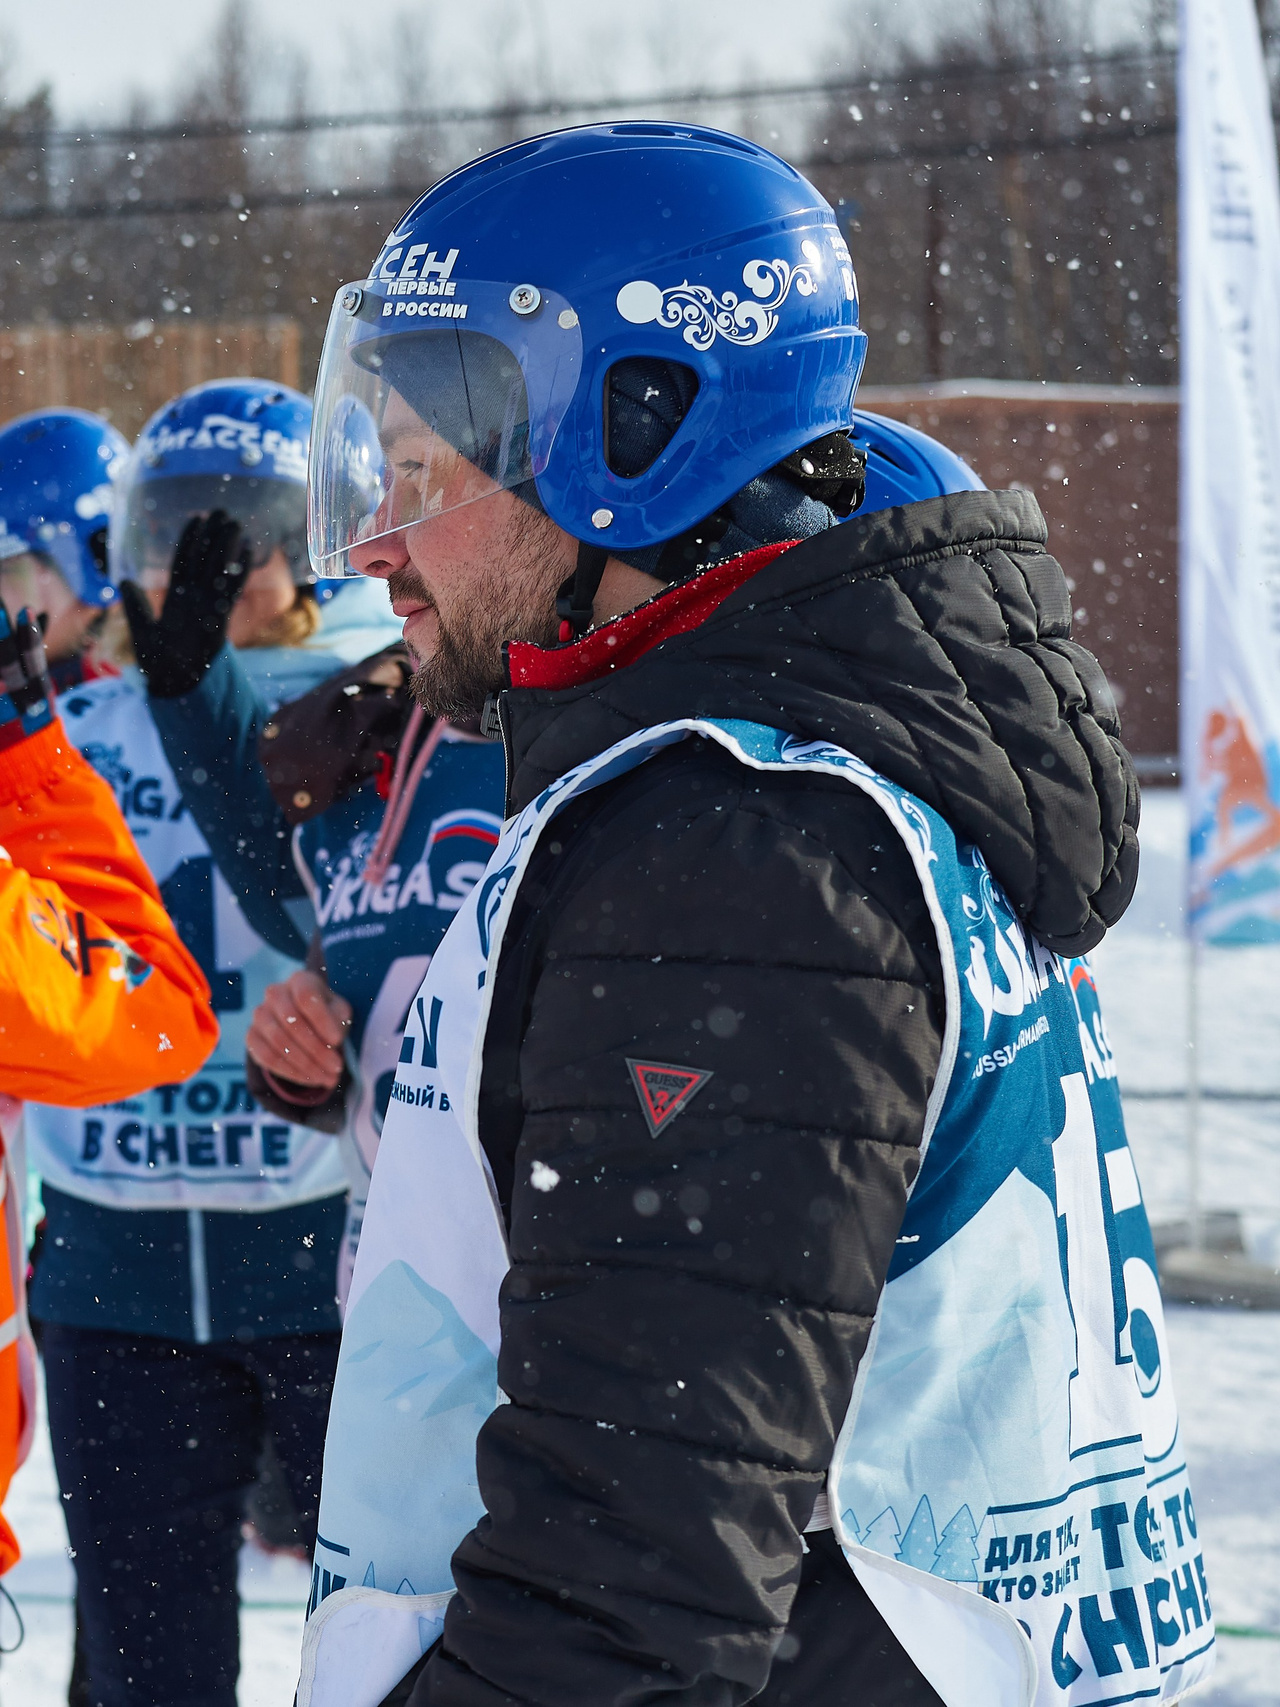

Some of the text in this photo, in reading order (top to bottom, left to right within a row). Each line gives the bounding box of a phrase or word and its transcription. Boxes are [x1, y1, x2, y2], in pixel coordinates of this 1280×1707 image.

[387, 281, 457, 296] ПЕРВЫЕ
[382, 302, 468, 319] В РОССИИ
[81, 1119, 292, 1168] В СНЕГЕ
[984, 1530, 1052, 1574] ДЛЯ
[982, 1574, 1037, 1604] КТО
